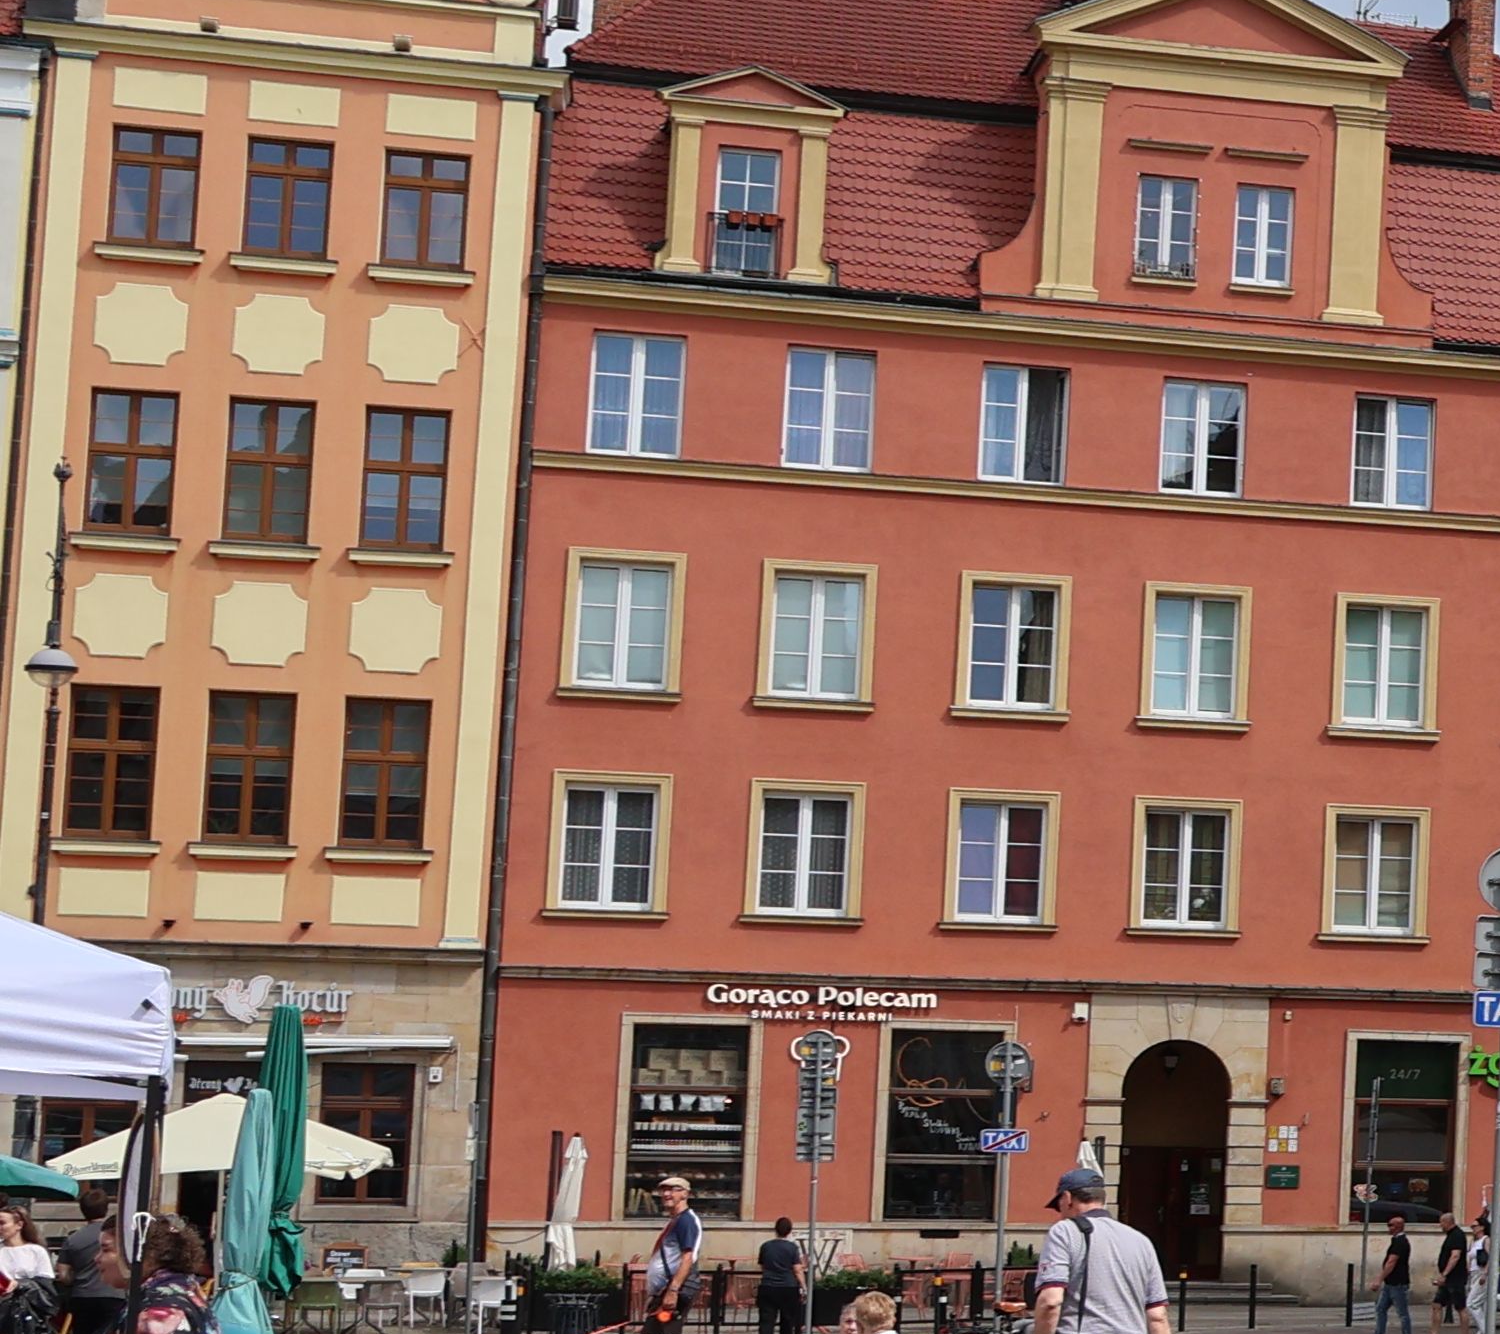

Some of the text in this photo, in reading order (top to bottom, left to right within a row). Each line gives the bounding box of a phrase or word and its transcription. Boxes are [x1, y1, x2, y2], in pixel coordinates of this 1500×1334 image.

[707, 984, 937, 1008] Gorąco Polecam
[751, 1010, 892, 1021] SMAKI Z PIEKARNI
[1390, 1069, 1421, 1080] 24/7
[984, 1132, 1026, 1149] TAXI
